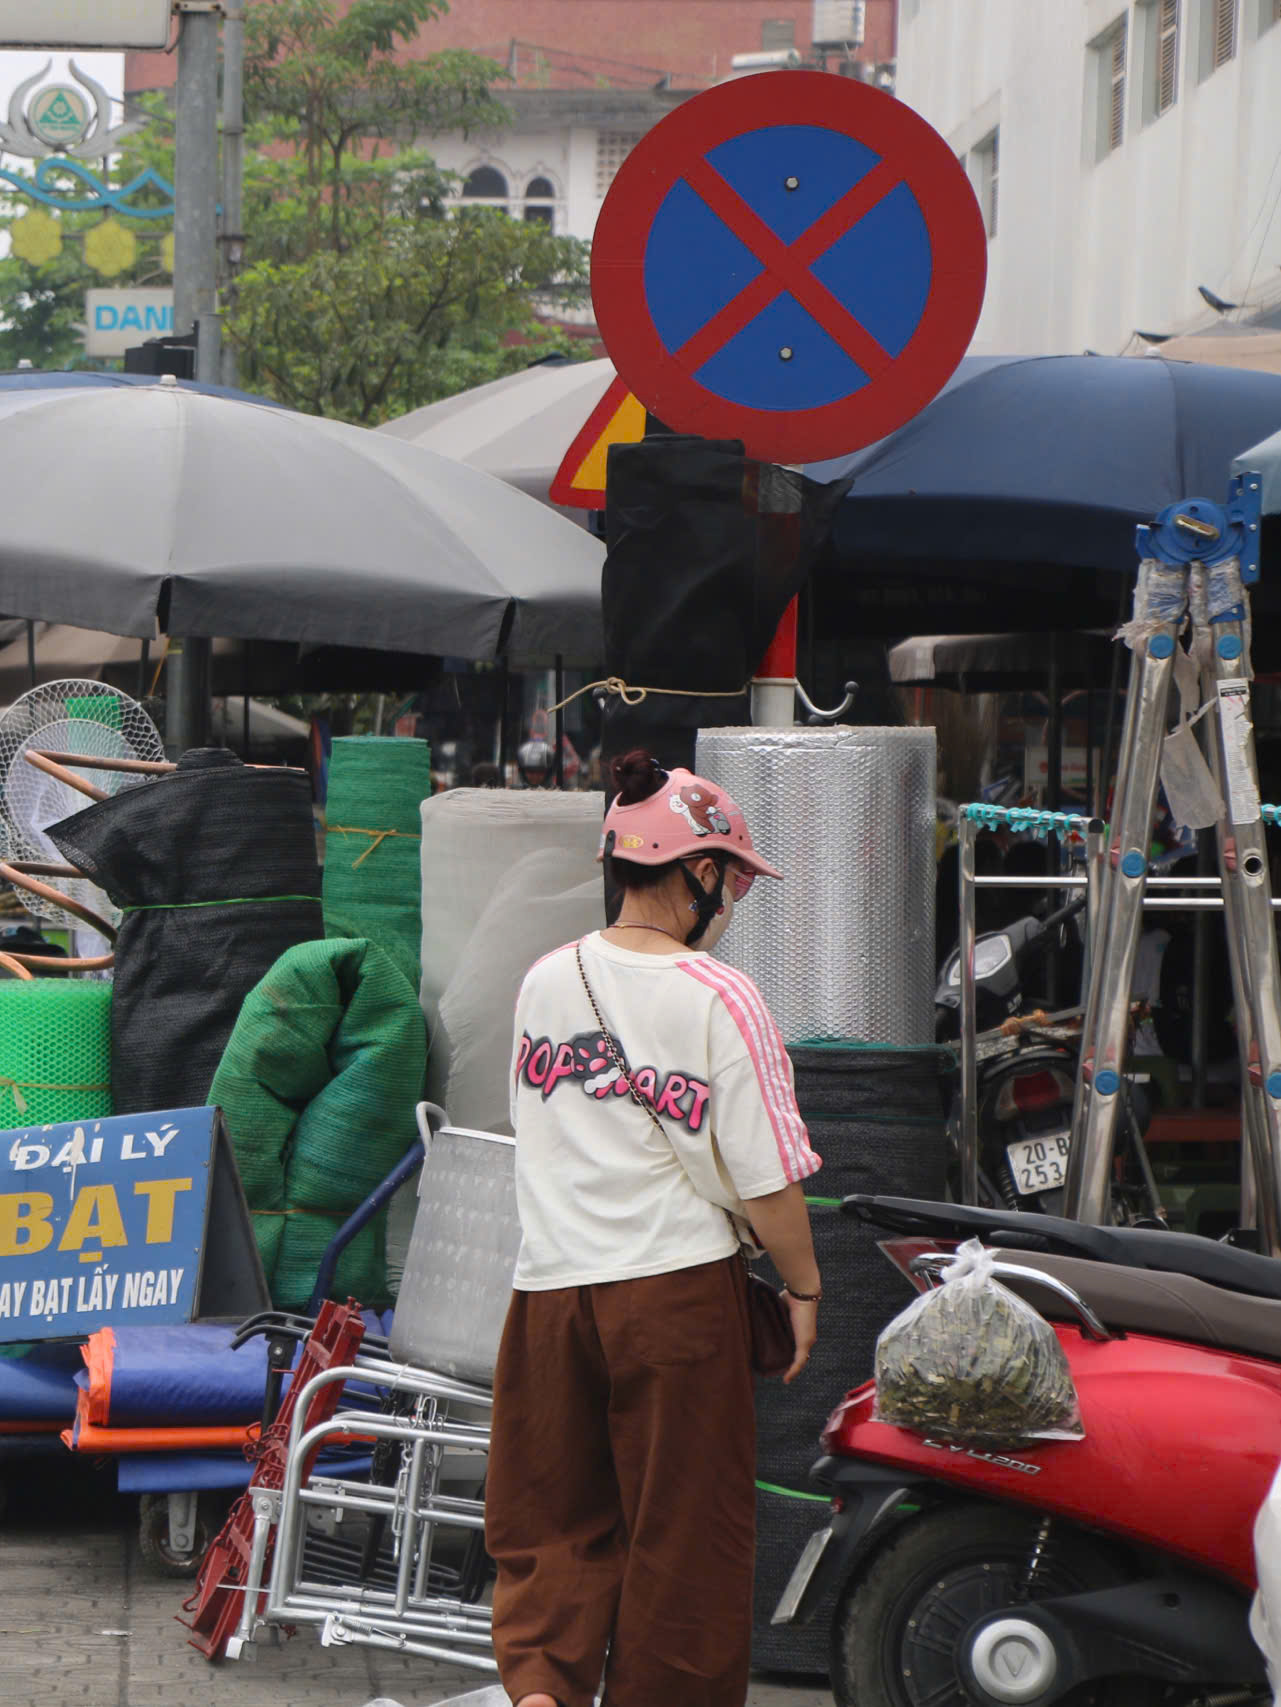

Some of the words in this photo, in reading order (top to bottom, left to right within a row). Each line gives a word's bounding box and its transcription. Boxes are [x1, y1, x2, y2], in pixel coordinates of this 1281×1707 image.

[120, 1123, 180, 1161] LÝ
[29, 1277, 73, 1322] BẠT
[76, 1264, 119, 1313] LẤY
[121, 1268, 184, 1309] NGAY
